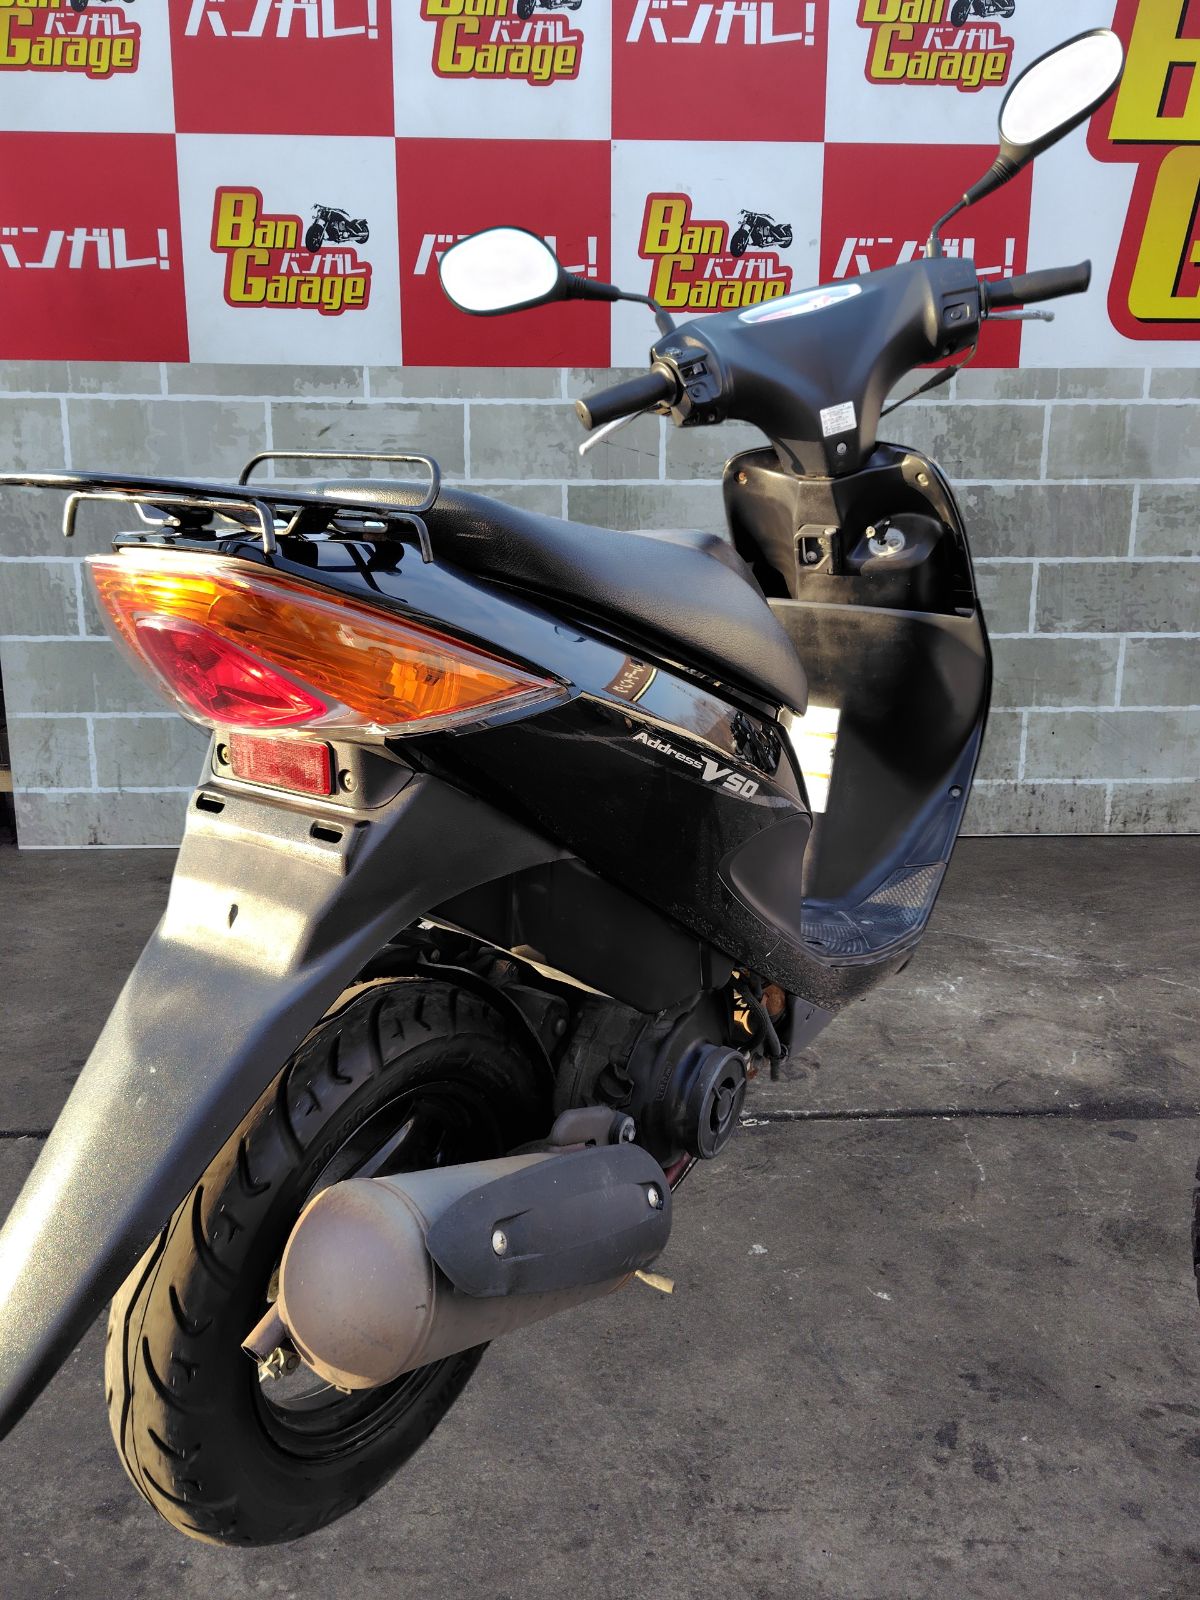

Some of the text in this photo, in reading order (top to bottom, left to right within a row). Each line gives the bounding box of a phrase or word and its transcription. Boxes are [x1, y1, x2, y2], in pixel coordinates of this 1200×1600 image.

[44, 12, 135, 36] バンガレ
[427, 0, 507, 16] an
[625, 0, 816, 46] バンガレ!
[0, 7, 135, 74] Garage
[437, 15, 577, 81] Garage
[489, 20, 578, 43] バンガレ
[922, 27, 1009, 50] バンガレ
[870, 23, 1008, 87] Garage
[216, 192, 298, 249] Ban
[644, 199, 725, 255] Ban
[229, 247, 367, 310] Garage
[279, 252, 367, 275] バンガレ
[703, 258, 788, 279] バンガレ
[632, 731, 703, 769] Address
